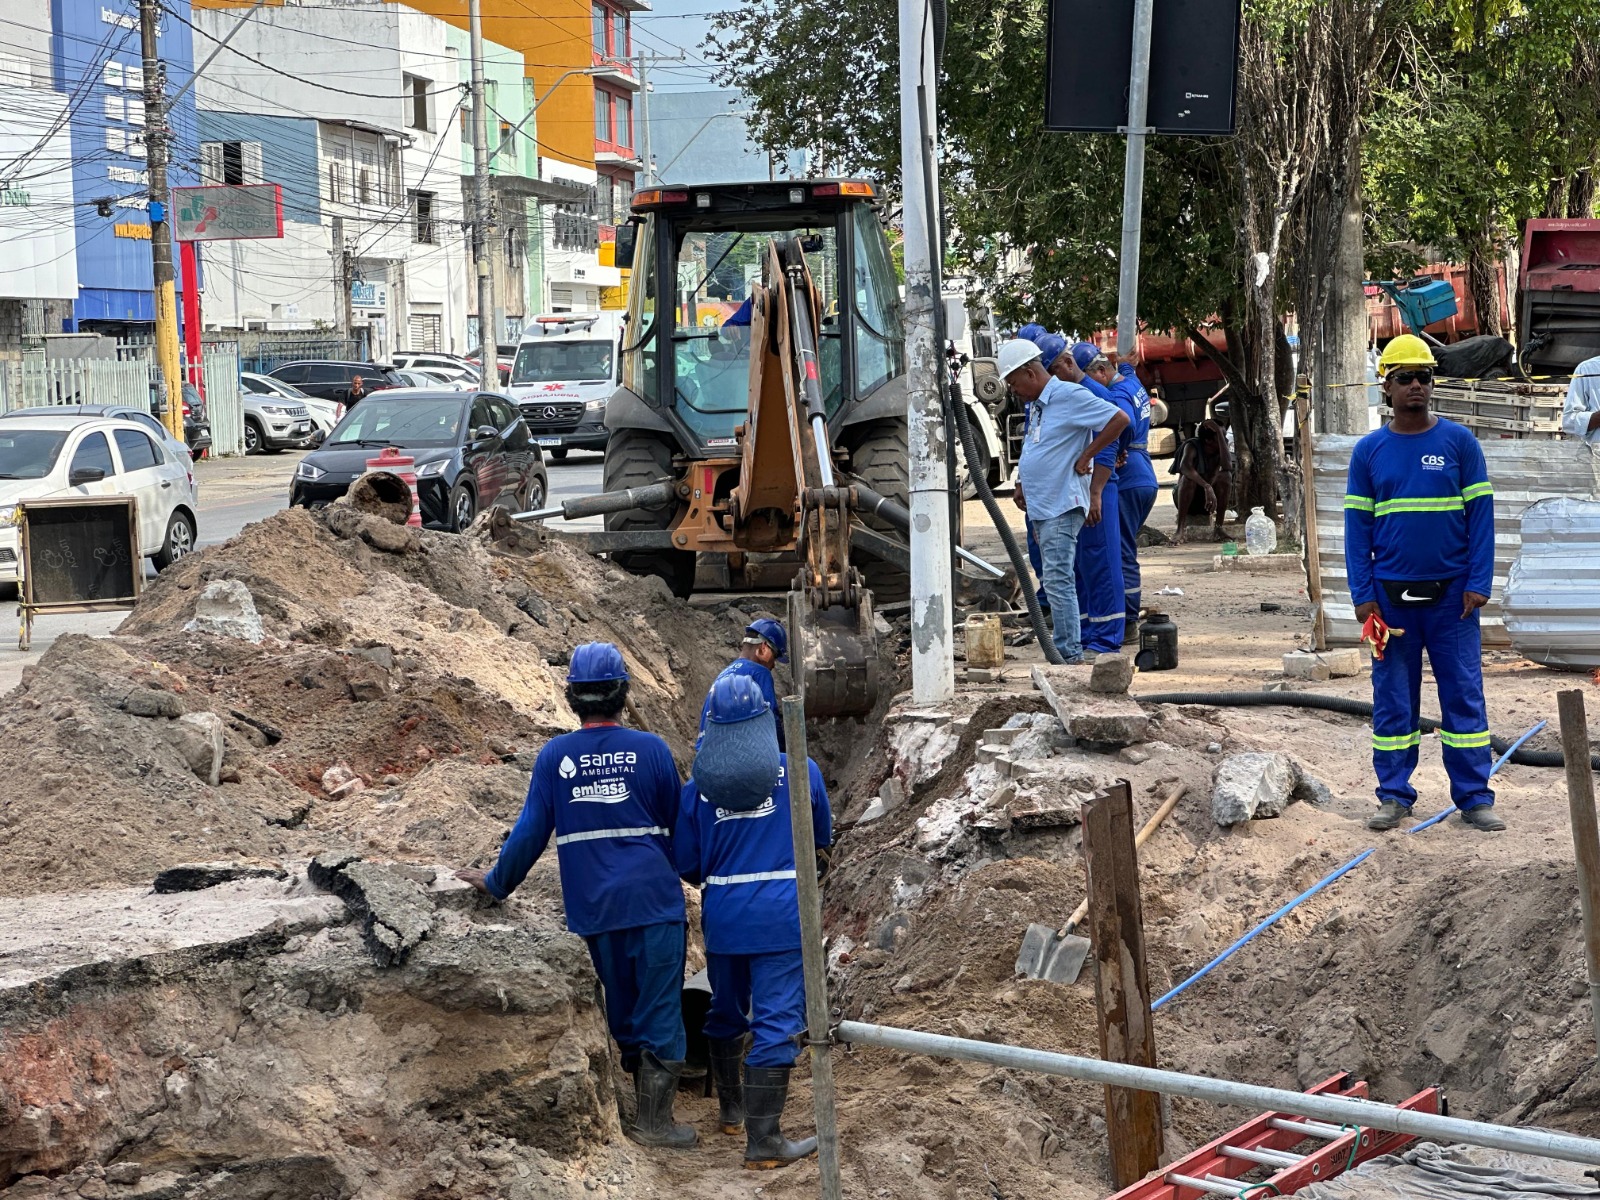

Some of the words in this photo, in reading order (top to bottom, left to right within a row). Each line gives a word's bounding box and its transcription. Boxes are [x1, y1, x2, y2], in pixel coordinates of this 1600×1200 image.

[1421, 455, 1445, 466] CBS
[582, 765, 635, 777] AMBIENTAL
[572, 781, 626, 798] embasa
